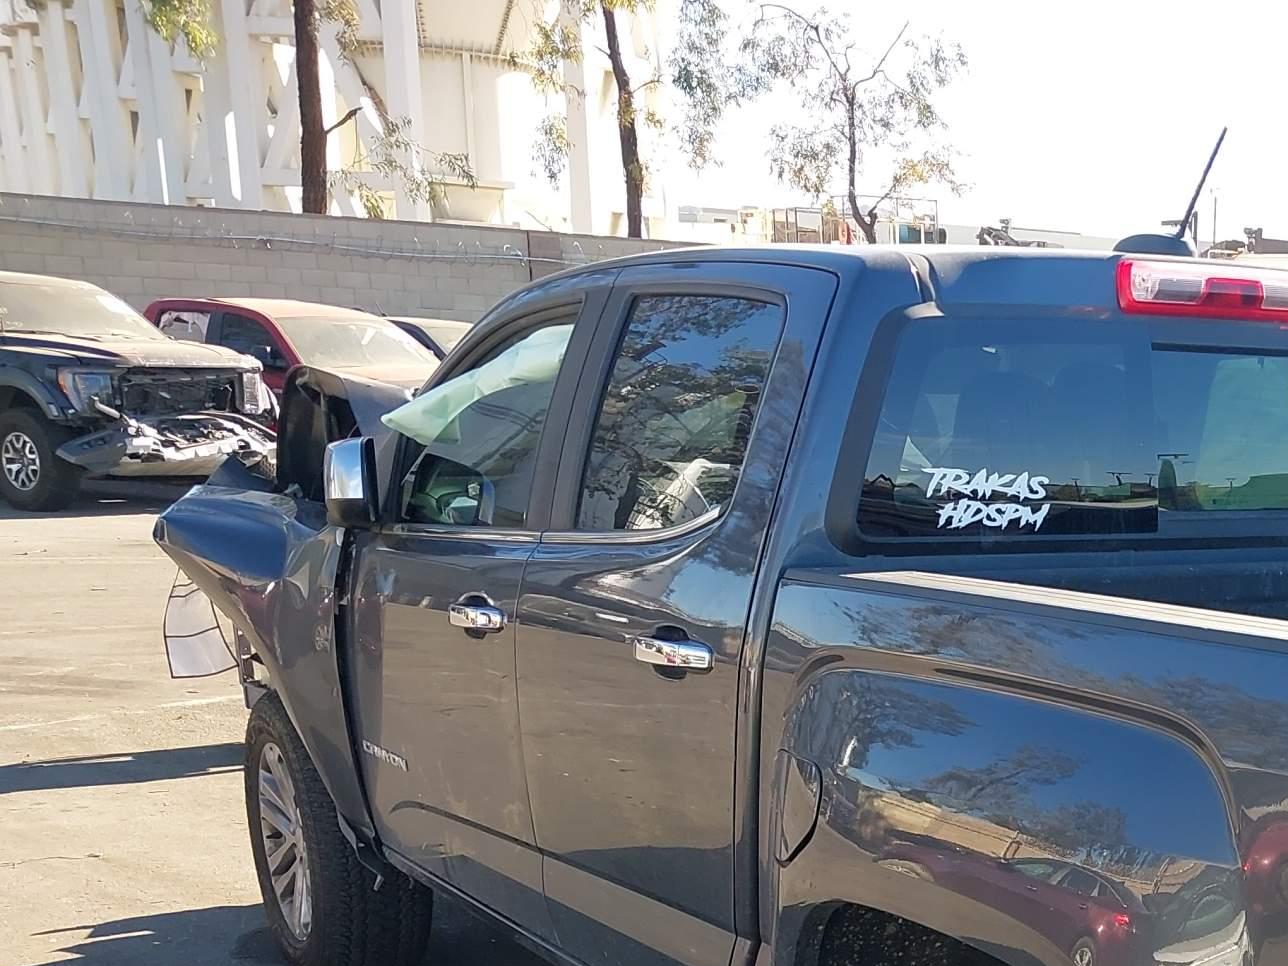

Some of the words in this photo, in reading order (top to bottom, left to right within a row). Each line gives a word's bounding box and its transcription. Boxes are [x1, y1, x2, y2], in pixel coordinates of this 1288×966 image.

[920, 467, 1050, 502] TRAKAS
[935, 498, 1051, 532] HDSPM
[362, 740, 409, 772] CANYON
